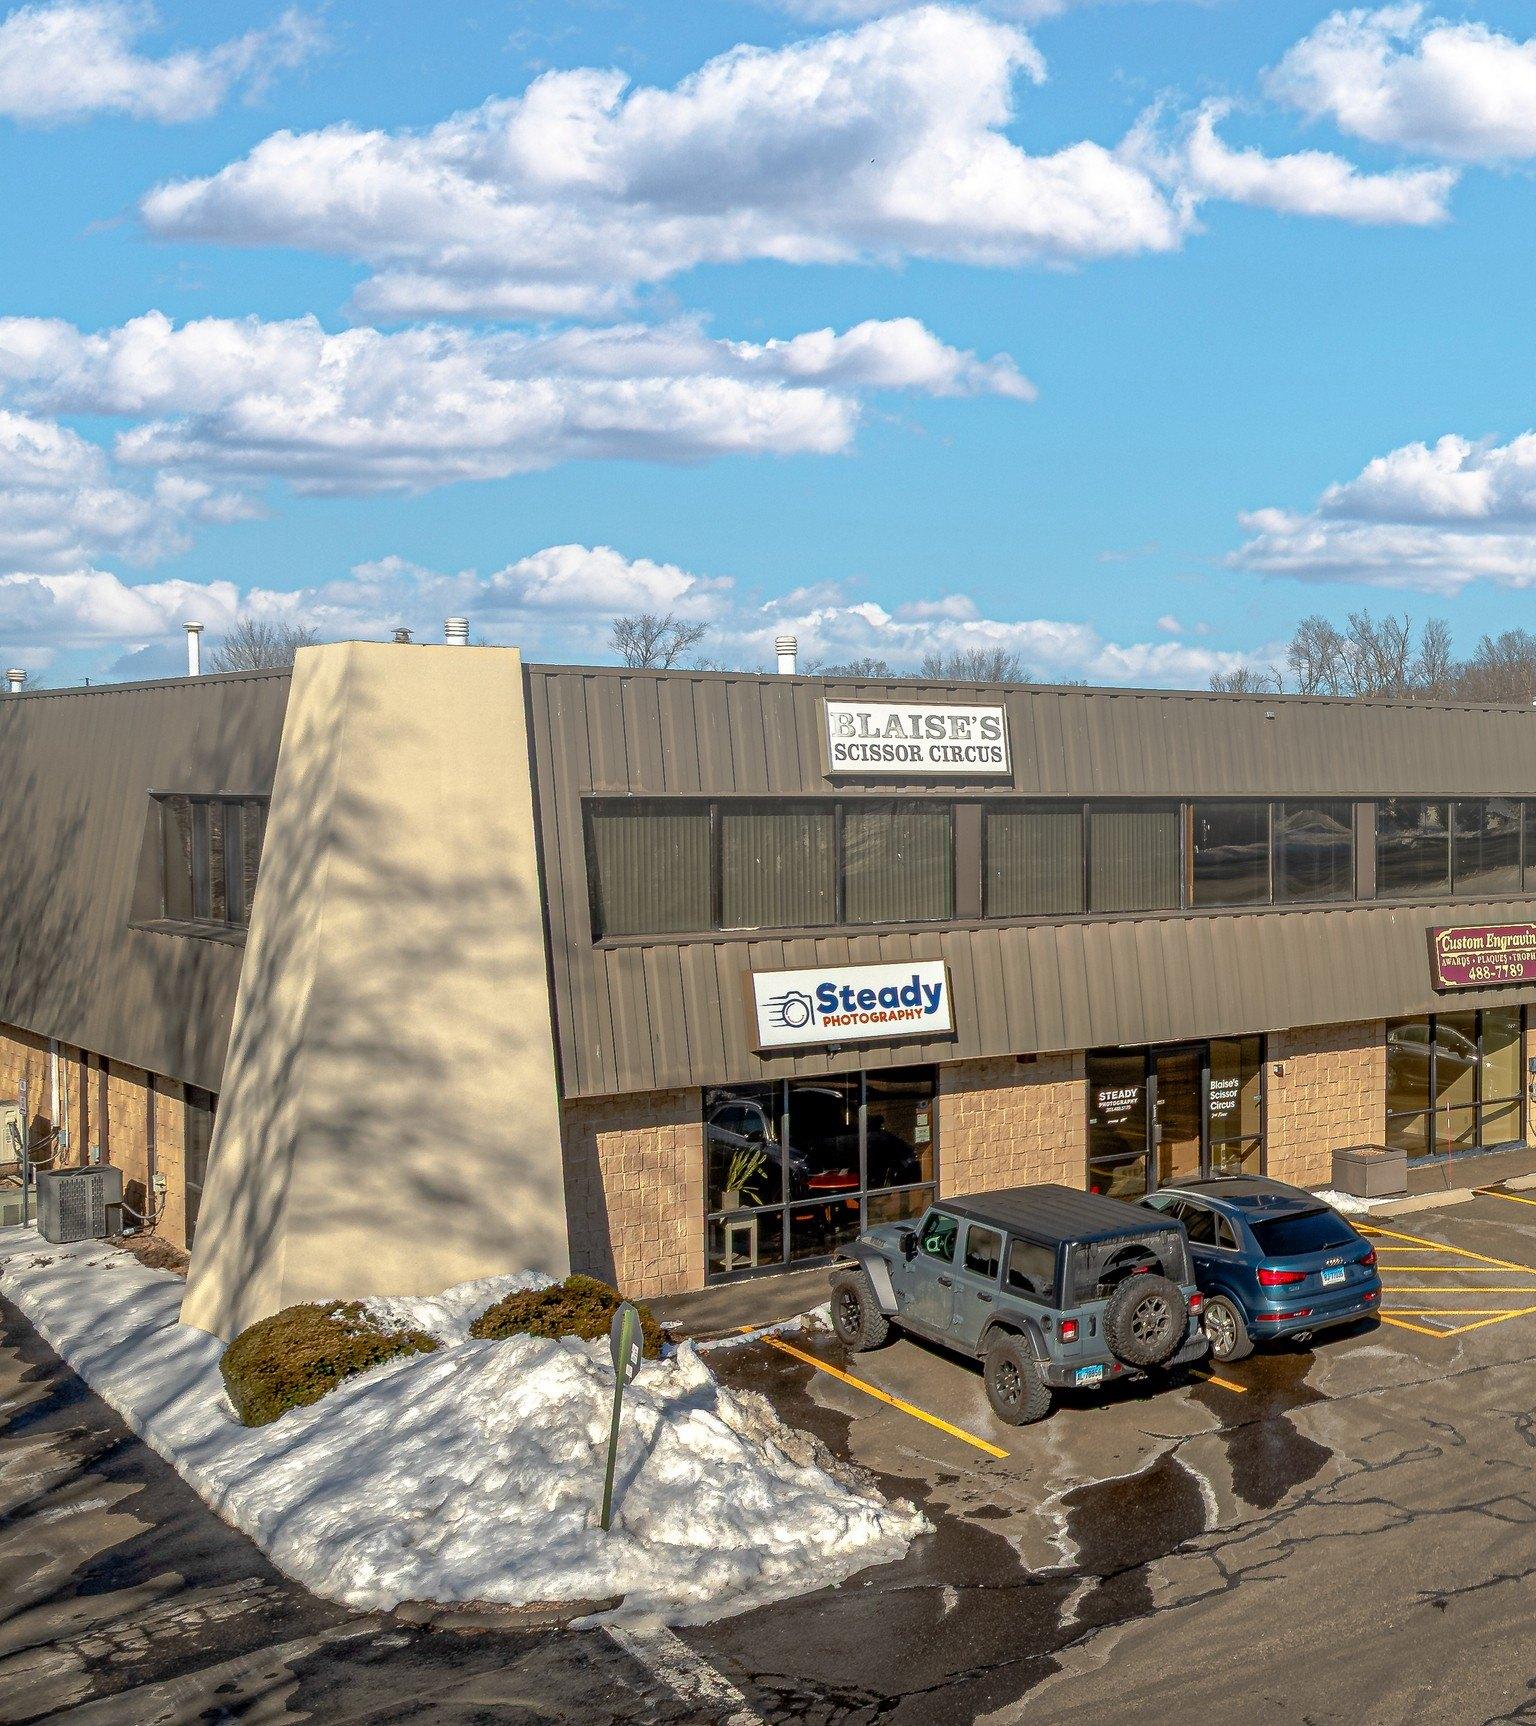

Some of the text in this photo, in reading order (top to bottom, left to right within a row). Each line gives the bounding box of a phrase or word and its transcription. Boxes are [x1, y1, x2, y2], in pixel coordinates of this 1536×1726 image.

[831, 712, 1002, 740] BLAISE'S
[834, 743, 1003, 763] SCISSOR CIRCUS
[1441, 935, 1484, 952] Custom
[1441, 956, 1471, 968] AWARDS
[1477, 954, 1508, 965] PLAQUES
[1468, 963, 1524, 980] 488-7789
[815, 974, 942, 1014] Steady
[823, 1008, 923, 1028] PHOTOGRAPHY
[1210, 1077, 1239, 1090] Blaise's
[1098, 1088, 1138, 1101] STEADY
[1210, 1090, 1238, 1100] Scissor
[1210, 1100, 1236, 1110] Circus
